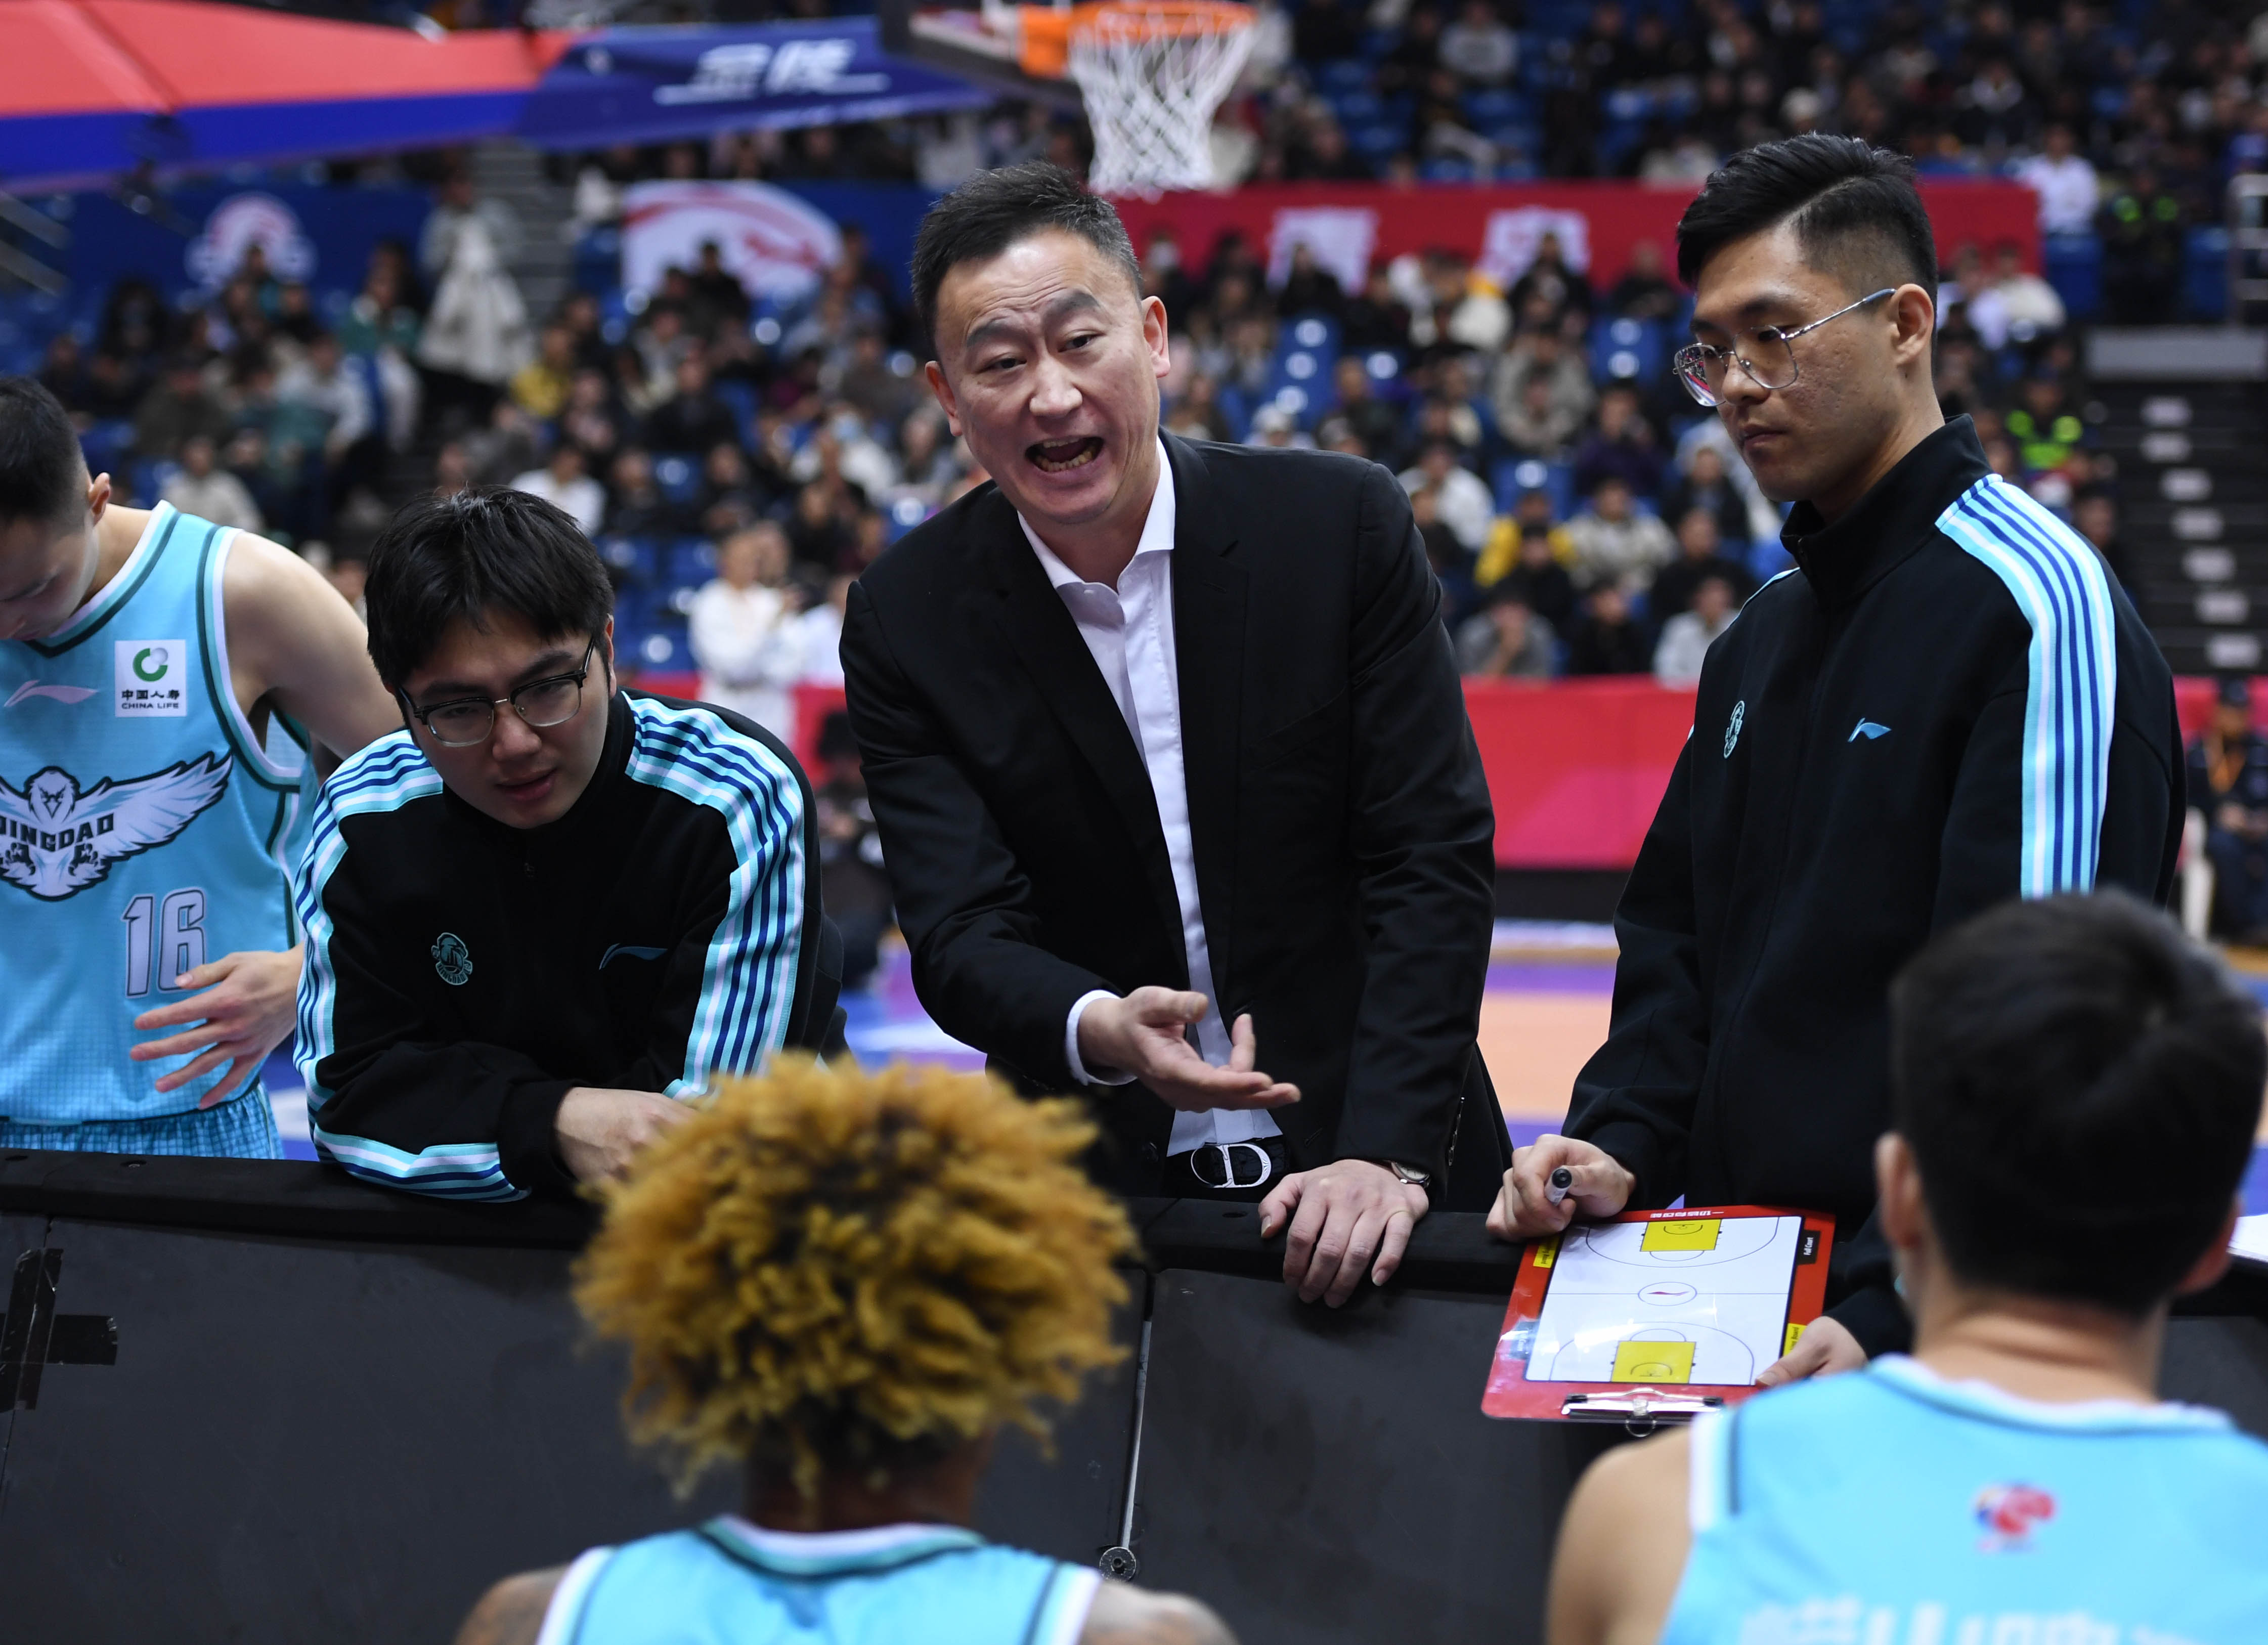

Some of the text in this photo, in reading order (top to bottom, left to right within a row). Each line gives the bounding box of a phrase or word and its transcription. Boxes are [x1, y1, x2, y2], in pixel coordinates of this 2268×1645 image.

[122, 689, 180, 701] 中国人寿
[121, 887, 206, 998] 16
[1803, 1237, 1814, 1256] Full Court
